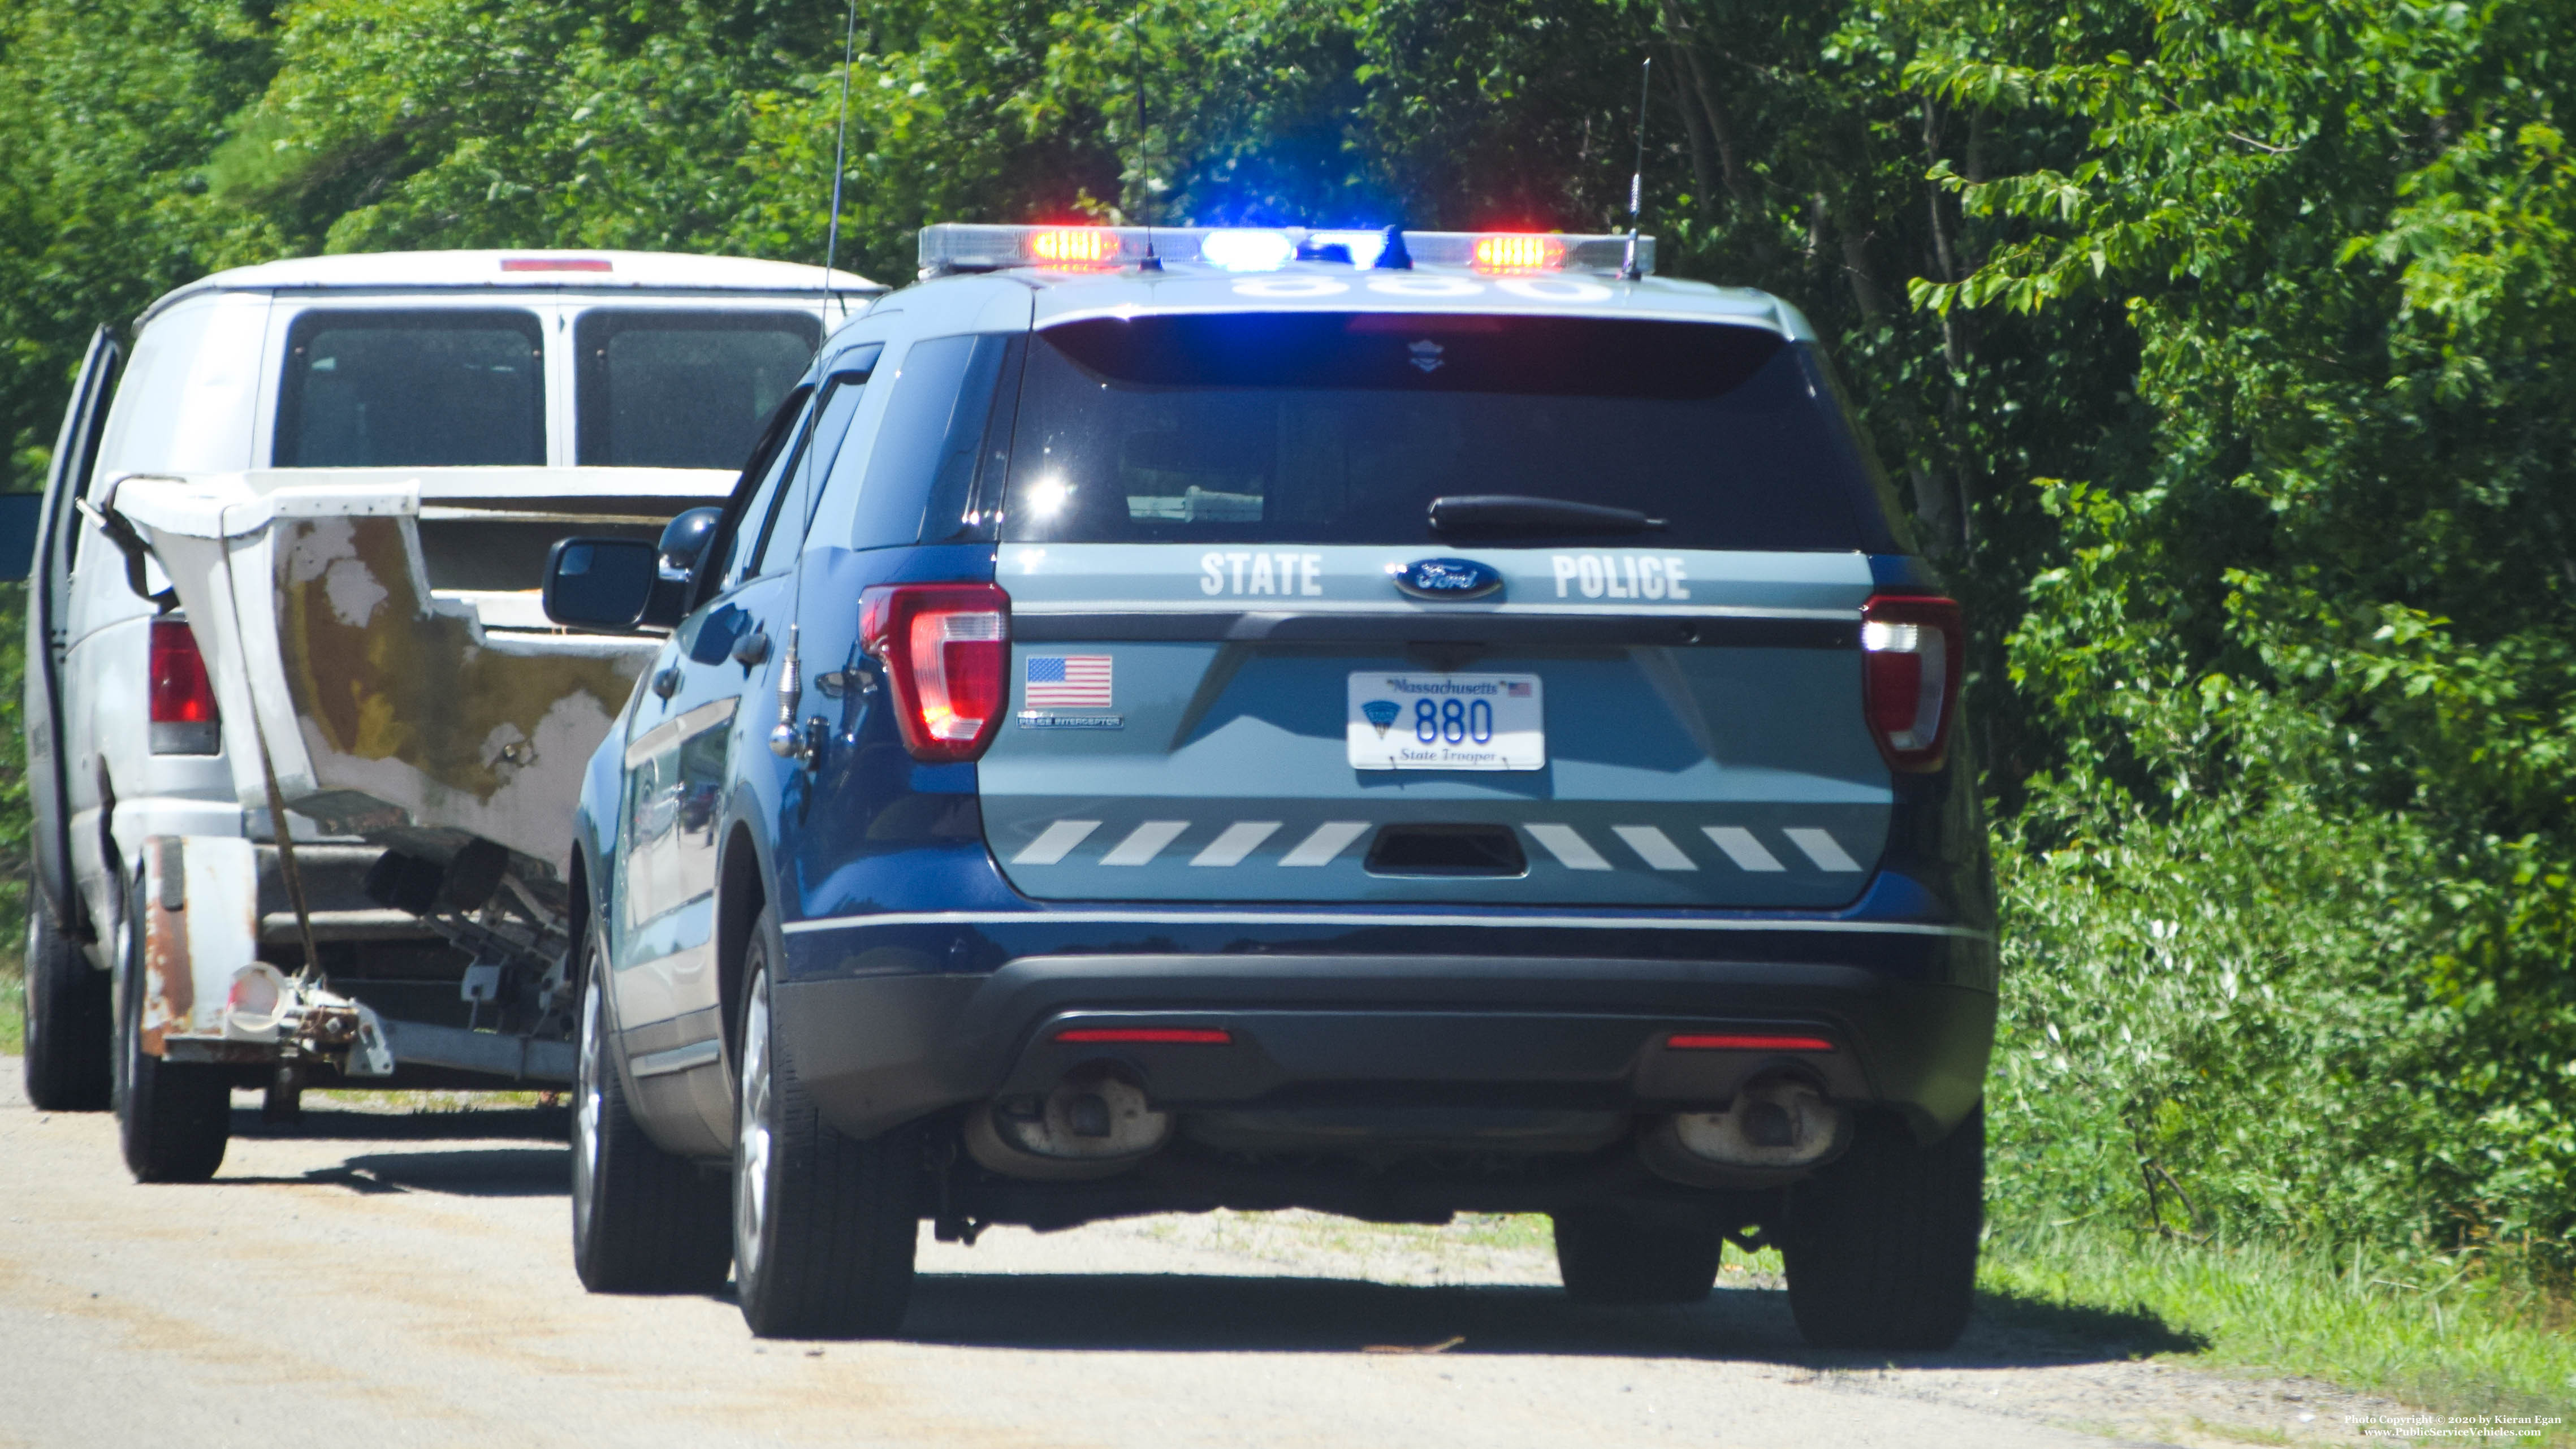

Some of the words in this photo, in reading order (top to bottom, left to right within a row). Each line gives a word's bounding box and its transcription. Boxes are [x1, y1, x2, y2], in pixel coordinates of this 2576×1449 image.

[1200, 552, 1322, 595] STATE
[1416, 563, 1477, 589] Ford
[1552, 555, 1691, 599] POLICE
[1393, 679, 1497, 694] Massachusetts
[1415, 698, 1493, 744] 880
[1401, 748, 1437, 761] State
[1442, 749, 1497, 764] Trooper
